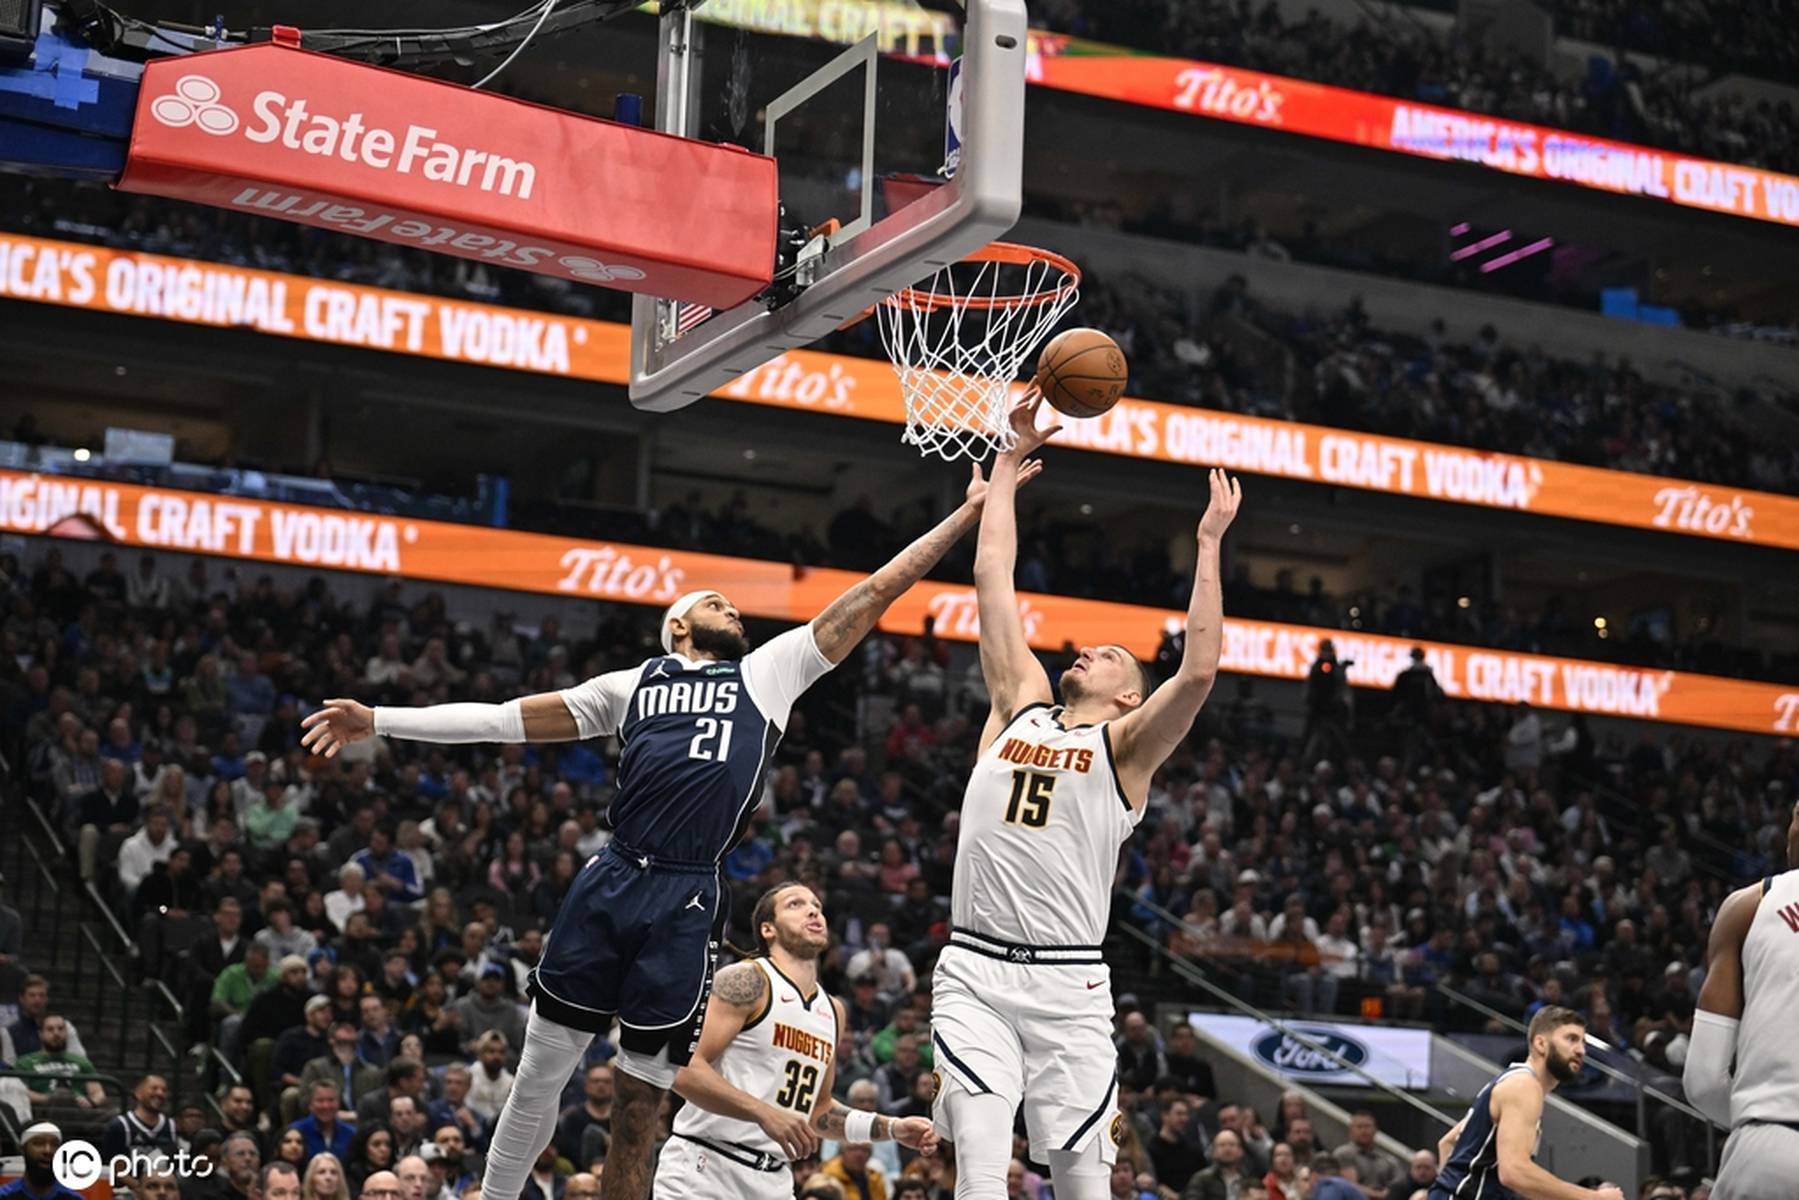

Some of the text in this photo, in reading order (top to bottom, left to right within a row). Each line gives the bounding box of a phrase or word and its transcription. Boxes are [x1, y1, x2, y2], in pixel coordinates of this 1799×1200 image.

[1173, 68, 1283, 123] Tito's
[1391, 106, 1538, 173] AMERICA'S
[1543, 135, 1669, 198] ORIGINAL
[1674, 159, 1758, 212] CRAFT
[106, 257, 294, 333] ORIGINAL
[304, 286, 431, 352] CRAFT
[1165, 413, 1312, 475] ORIGINAL
[1319, 435, 1417, 492] CRAFT
[137, 495, 261, 554] CRAFT
[1652, 485, 1754, 537] Tito's
[557, 546, 686, 601] Tito's
[929, 591, 1044, 643] Ti's
[639, 681, 739, 720] MAVS
[1466, 653, 1556, 705] CRAFT
[688, 717, 733, 762] 21
[1004, 768, 1057, 830] 15
[776, 1058, 819, 1115] 32
